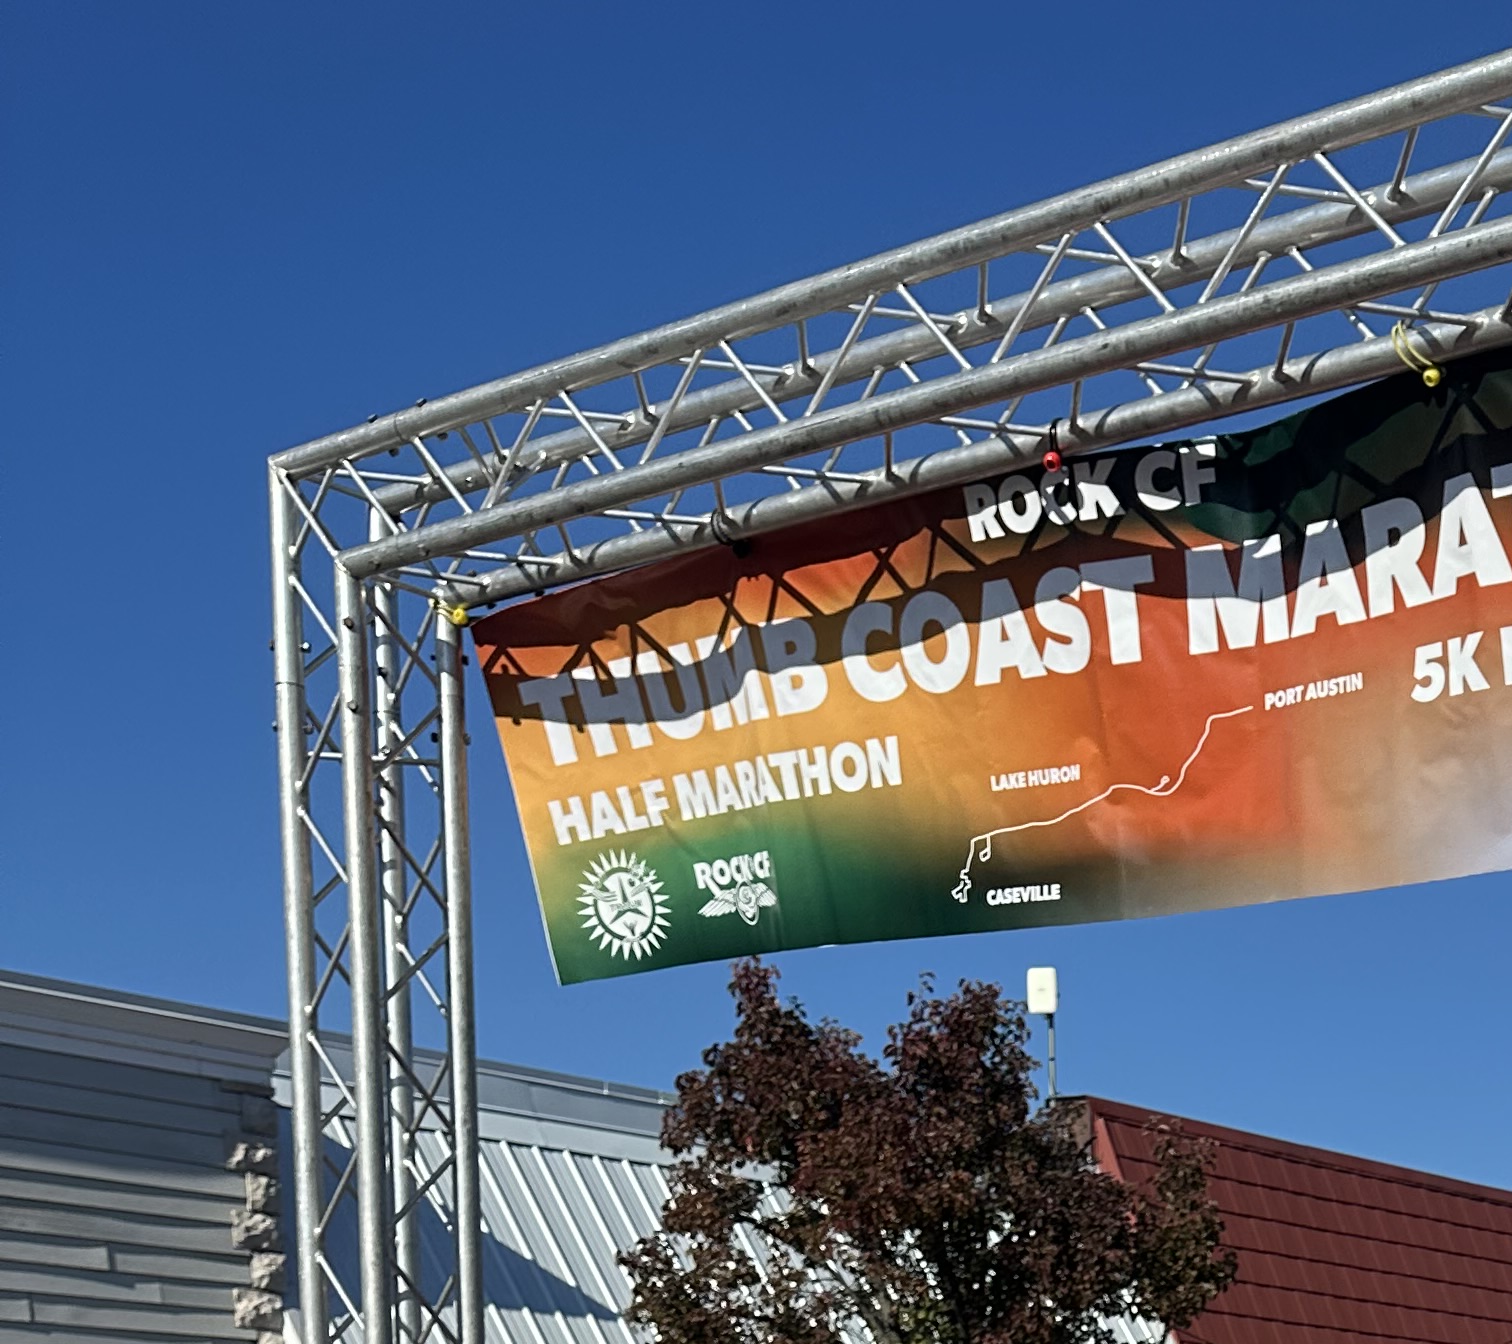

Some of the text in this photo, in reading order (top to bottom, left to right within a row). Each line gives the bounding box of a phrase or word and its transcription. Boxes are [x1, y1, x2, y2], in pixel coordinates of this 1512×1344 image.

[963, 443, 1217, 543] ROCK CF
[520, 617, 828, 766] THUMB
[841, 555, 1155, 703] COAST
[1411, 631, 1491, 702] 5K
[1264, 672, 1363, 711] PORT AUSTIN
[547, 735, 902, 846] HALF MARATHON
[990, 763, 1081, 792] LAKE HURON
[693, 854, 753, 897] ROCK
[986, 882, 1061, 906] CASEVILLE
